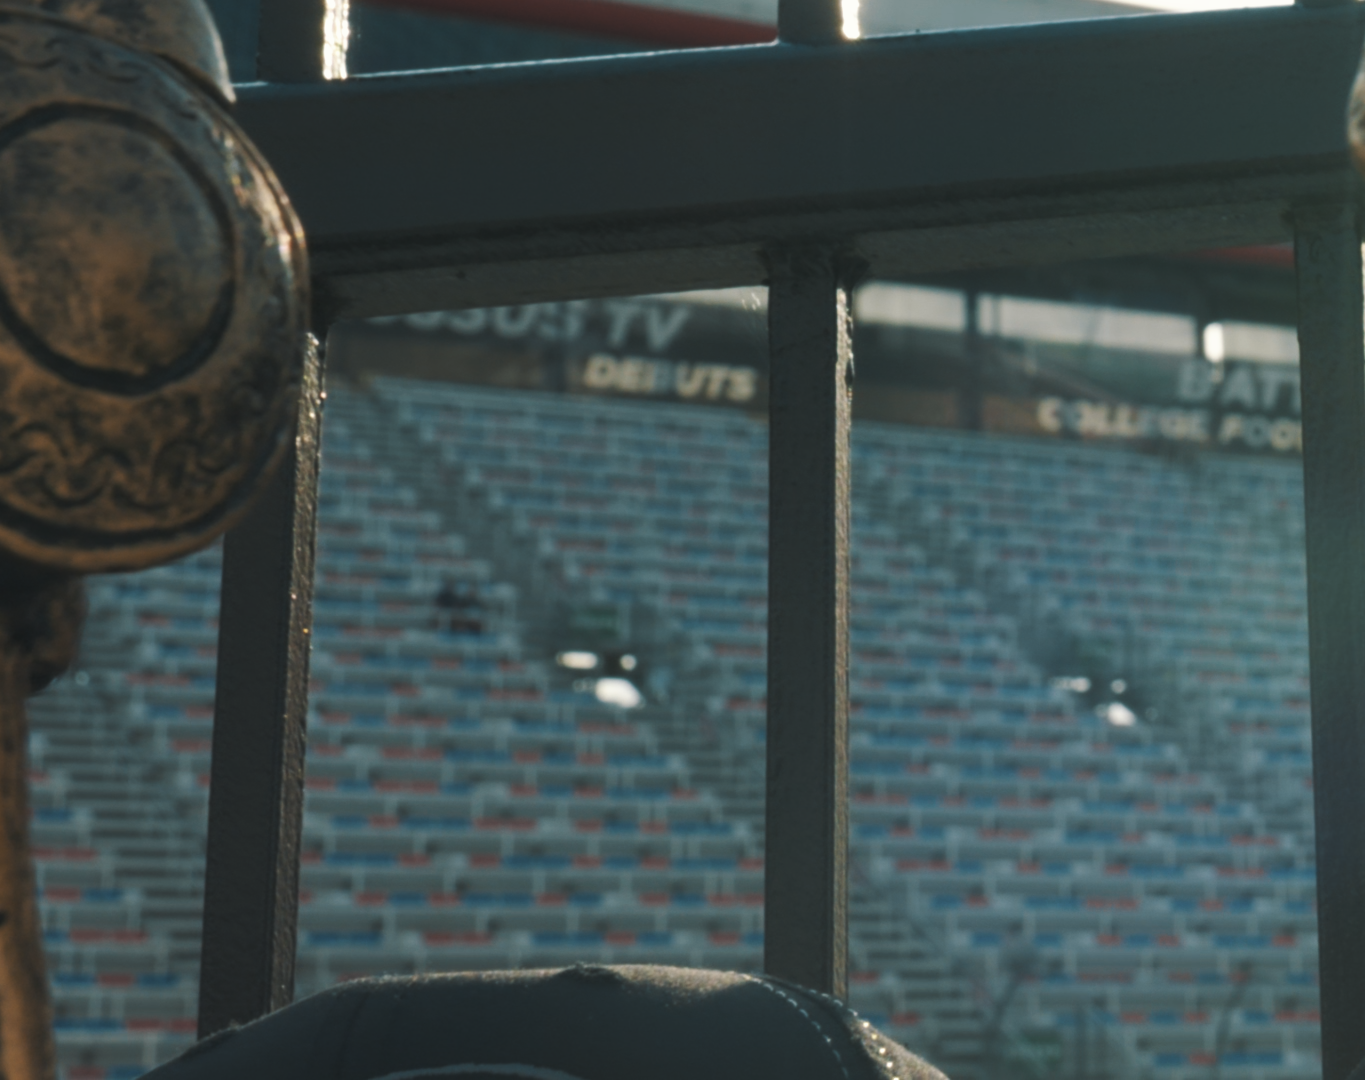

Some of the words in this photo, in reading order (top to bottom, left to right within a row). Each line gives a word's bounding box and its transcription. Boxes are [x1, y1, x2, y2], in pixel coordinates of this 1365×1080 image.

[604, 302, 691, 352] TV
[583, 353, 758, 402] DEBUTS
[1037, 397, 1210, 441] COLLEGE
[1218, 413, 1302, 451] FOO
